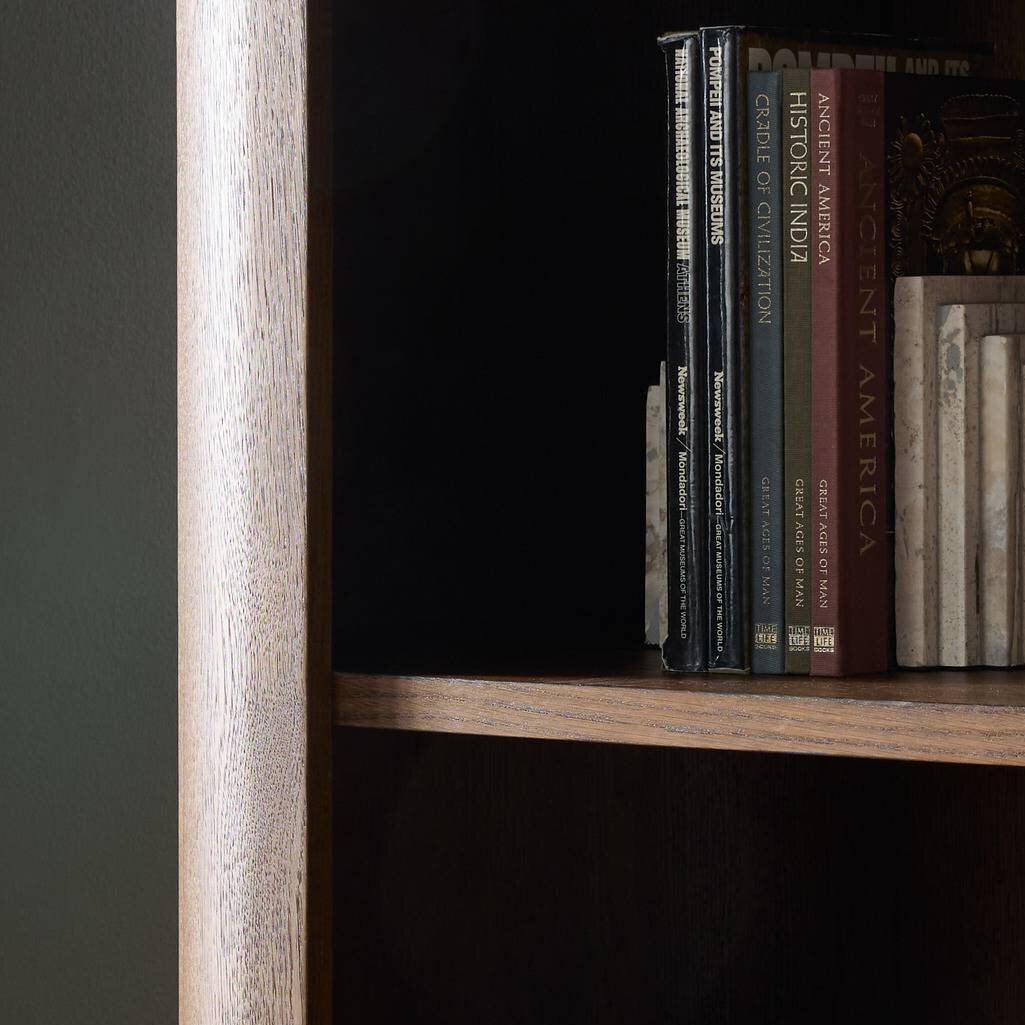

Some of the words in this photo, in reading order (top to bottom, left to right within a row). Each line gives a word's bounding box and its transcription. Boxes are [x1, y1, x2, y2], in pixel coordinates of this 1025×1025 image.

[710, 110, 723, 141] AND
[756, 94, 770, 163] CRADLE
[790, 92, 807, 196] HISTORIC
[818, 93, 831, 176] ANCIENT
[675, 108, 690, 207] ARCHAEOLOGICAL
[710, 145, 723, 168] ITS
[757, 171, 770, 194] OF
[711, 171, 724, 246] MUSEUMS
[818, 184, 831, 265] AMERICA
[676, 209, 690, 260] MUSEUM
[790, 203, 808, 262] INDIA
[858, 152, 878, 344] ANCIENT
[757, 202, 771, 324] CIVILIZATION
[676, 263, 691, 323] ATHENS
[678, 366, 689, 435] Newsweek
[714, 370, 724, 443] Newsweek
[858, 363, 878, 556] AMERICA
[762, 477, 770, 516] GREAT
[796, 478, 804, 518] GREAT
[819, 480, 828, 519] GREAT
[762, 520, 770, 551] AGES
[796, 521, 804, 553] AGES
[819, 522, 828, 554] AGES
[762, 555, 770, 572] OF
[796, 557, 804, 574] OF
[819, 558, 828, 575] OF
[680, 584, 687, 594] OF
[716, 592, 723, 604] OF
[762, 575, 771, 606] MAN
[796, 578, 804, 607] MAN
[819, 579, 828, 608] MAN
[814, 636, 835, 647] LIFE
